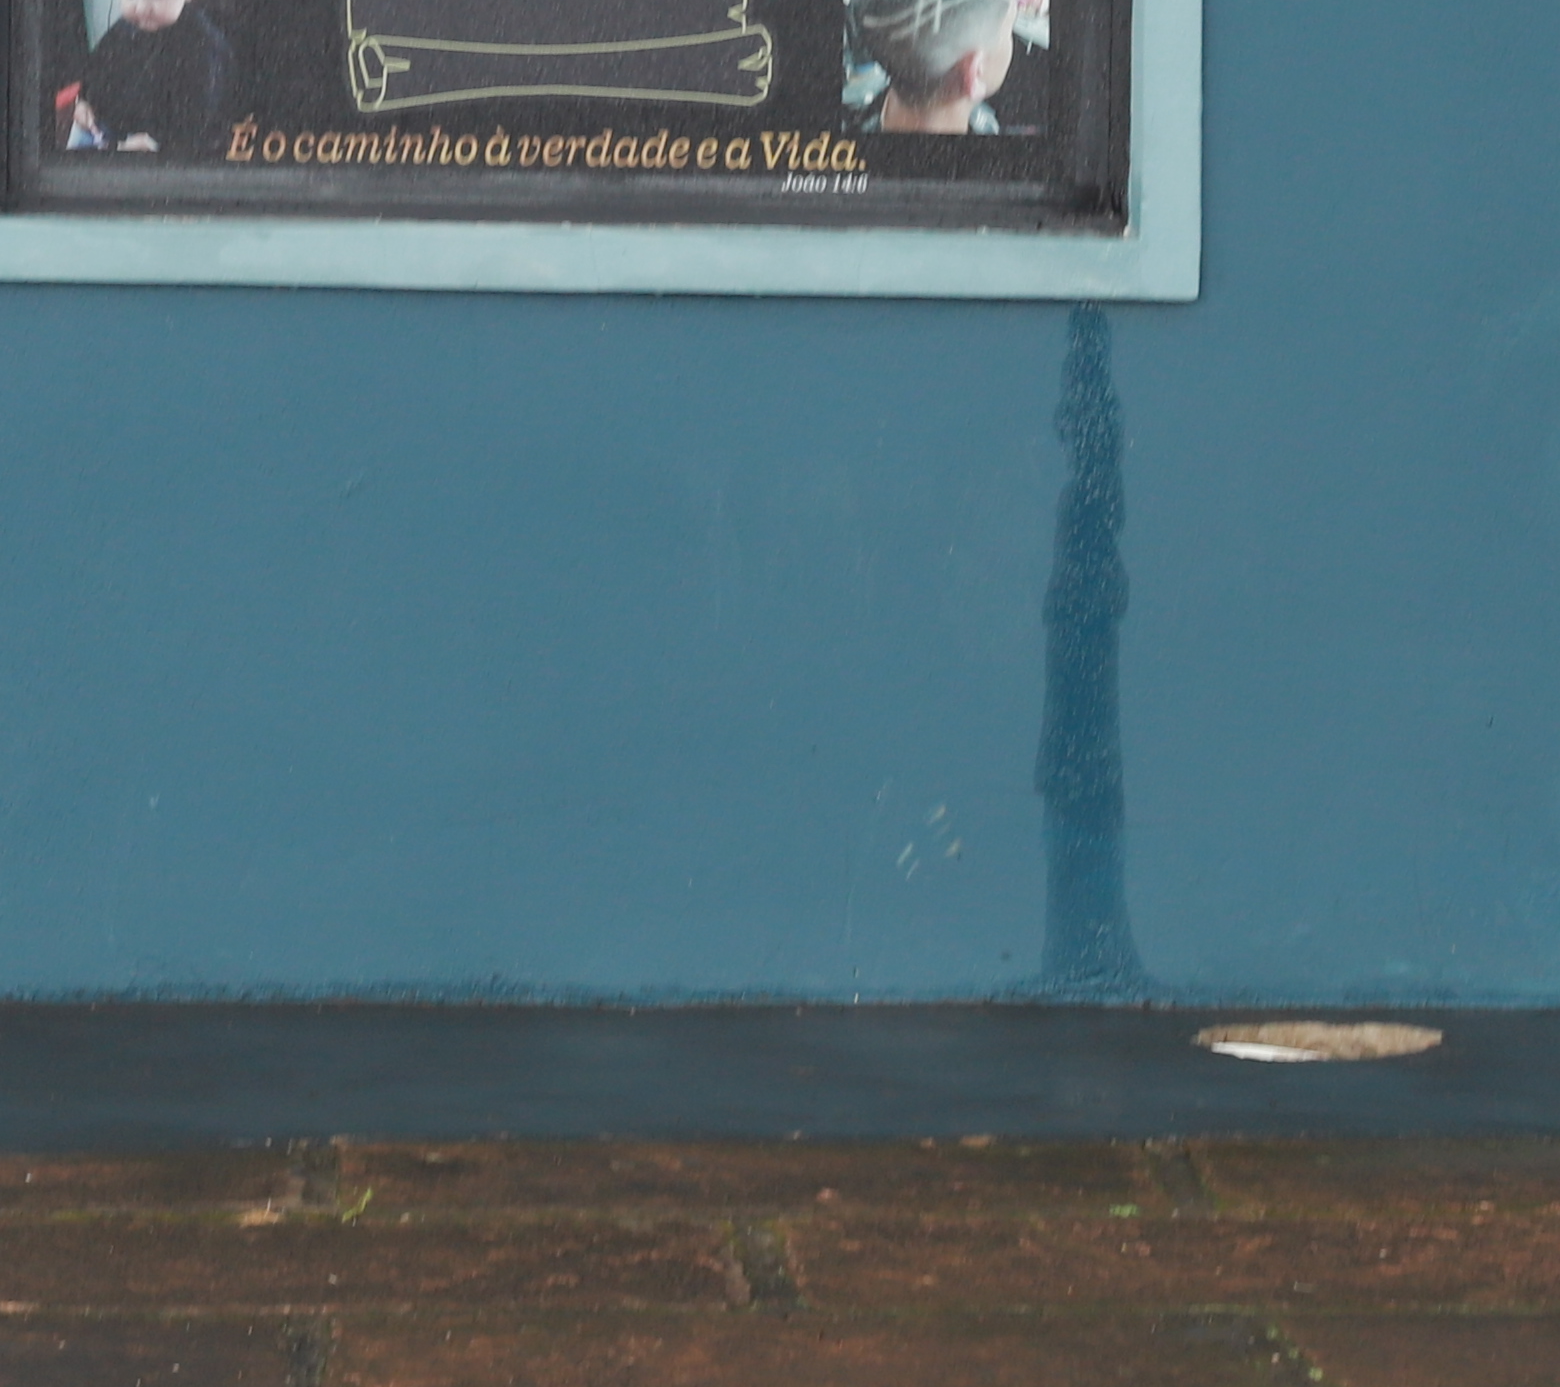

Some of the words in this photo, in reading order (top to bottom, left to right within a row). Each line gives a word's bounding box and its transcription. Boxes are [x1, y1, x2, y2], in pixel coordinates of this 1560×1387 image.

[225, 112, 258, 162] É
[262, 130, 287, 164] o
[293, 124, 479, 167] caminho
[516, 127, 691, 170] verdade
[696, 135, 718, 170] e
[725, 136, 752, 171] a
[760, 129, 867, 172] Vida.
